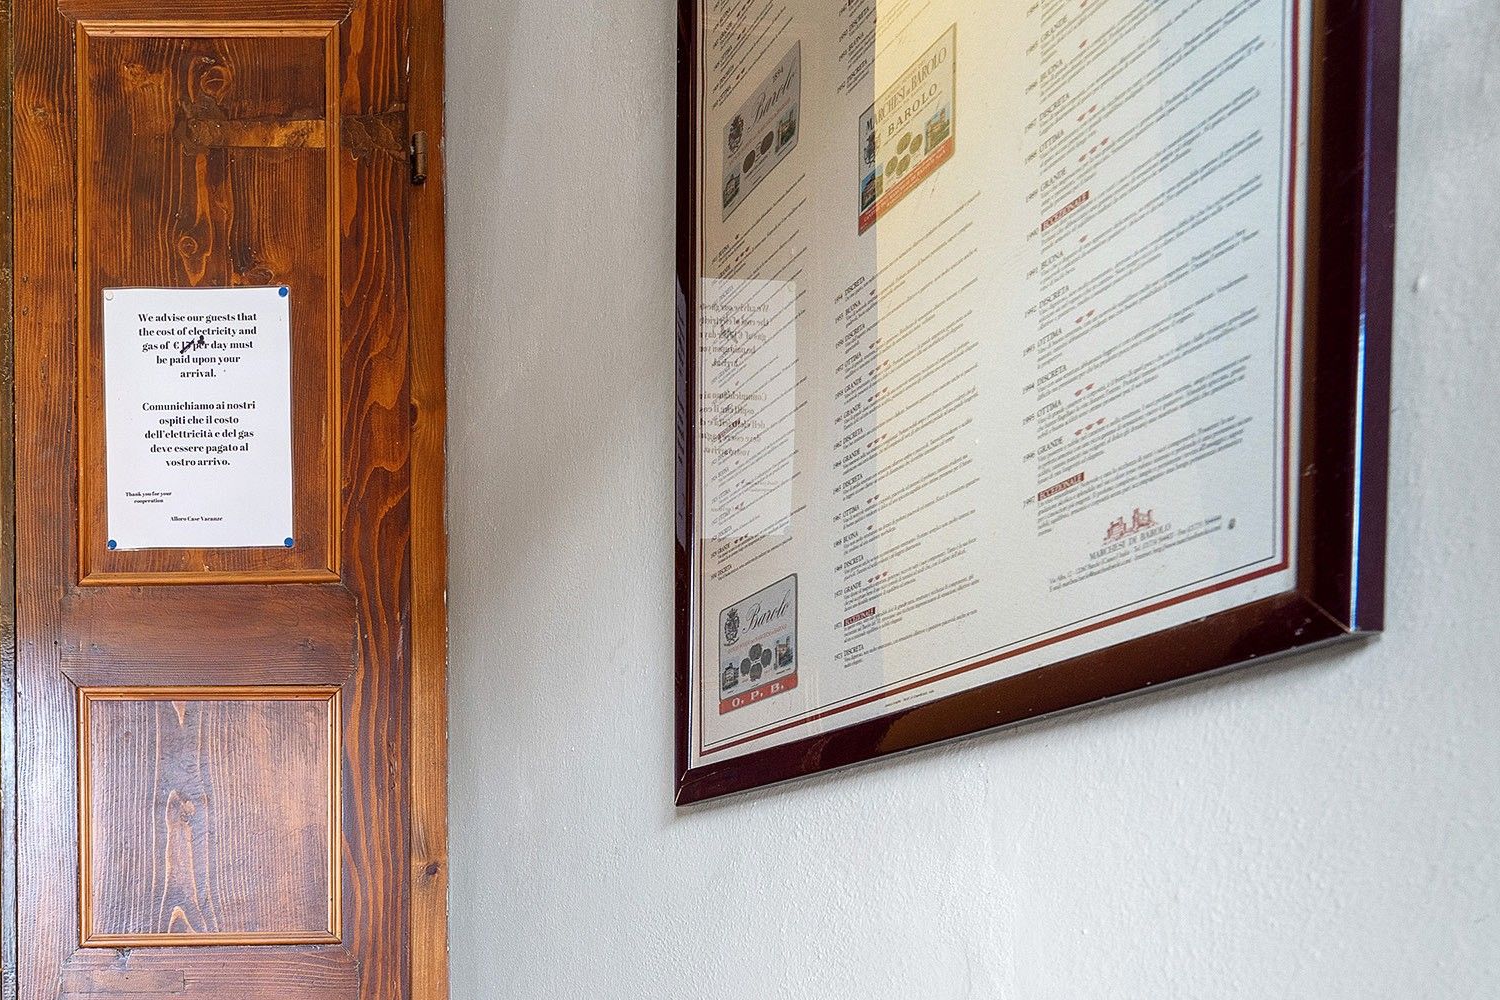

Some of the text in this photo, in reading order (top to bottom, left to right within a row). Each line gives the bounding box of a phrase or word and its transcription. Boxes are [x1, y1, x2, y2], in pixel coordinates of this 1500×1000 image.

[911, 46, 948, 87] BAROLO
[888, 83, 938, 136] BAROLO
[138, 312, 257, 324] We advise our guests that
[138, 326, 257, 337] the cost of electricity and
[142, 342, 158, 352] gas
[160, 341, 170, 350] of
[193, 341, 209, 351] per
[211, 340, 228, 351] day
[230, 341, 253, 349] must
[156, 354, 241, 366] be paid upon your
[180, 368, 217, 378] arrival.
[142, 401, 256, 411] Comunichiamo ai nostri
[159, 415, 239, 426] ospiti che il costo
[221, 429, 237, 437] del
[238, 430, 255, 440] gas
[150, 442, 249, 454] deve essere pagato al
[166, 457, 231, 467] vostro arrivo.
[1089, 522, 1172, 560] MARCHESI DI BAROLO
[742, 588, 791, 635] Barolo
